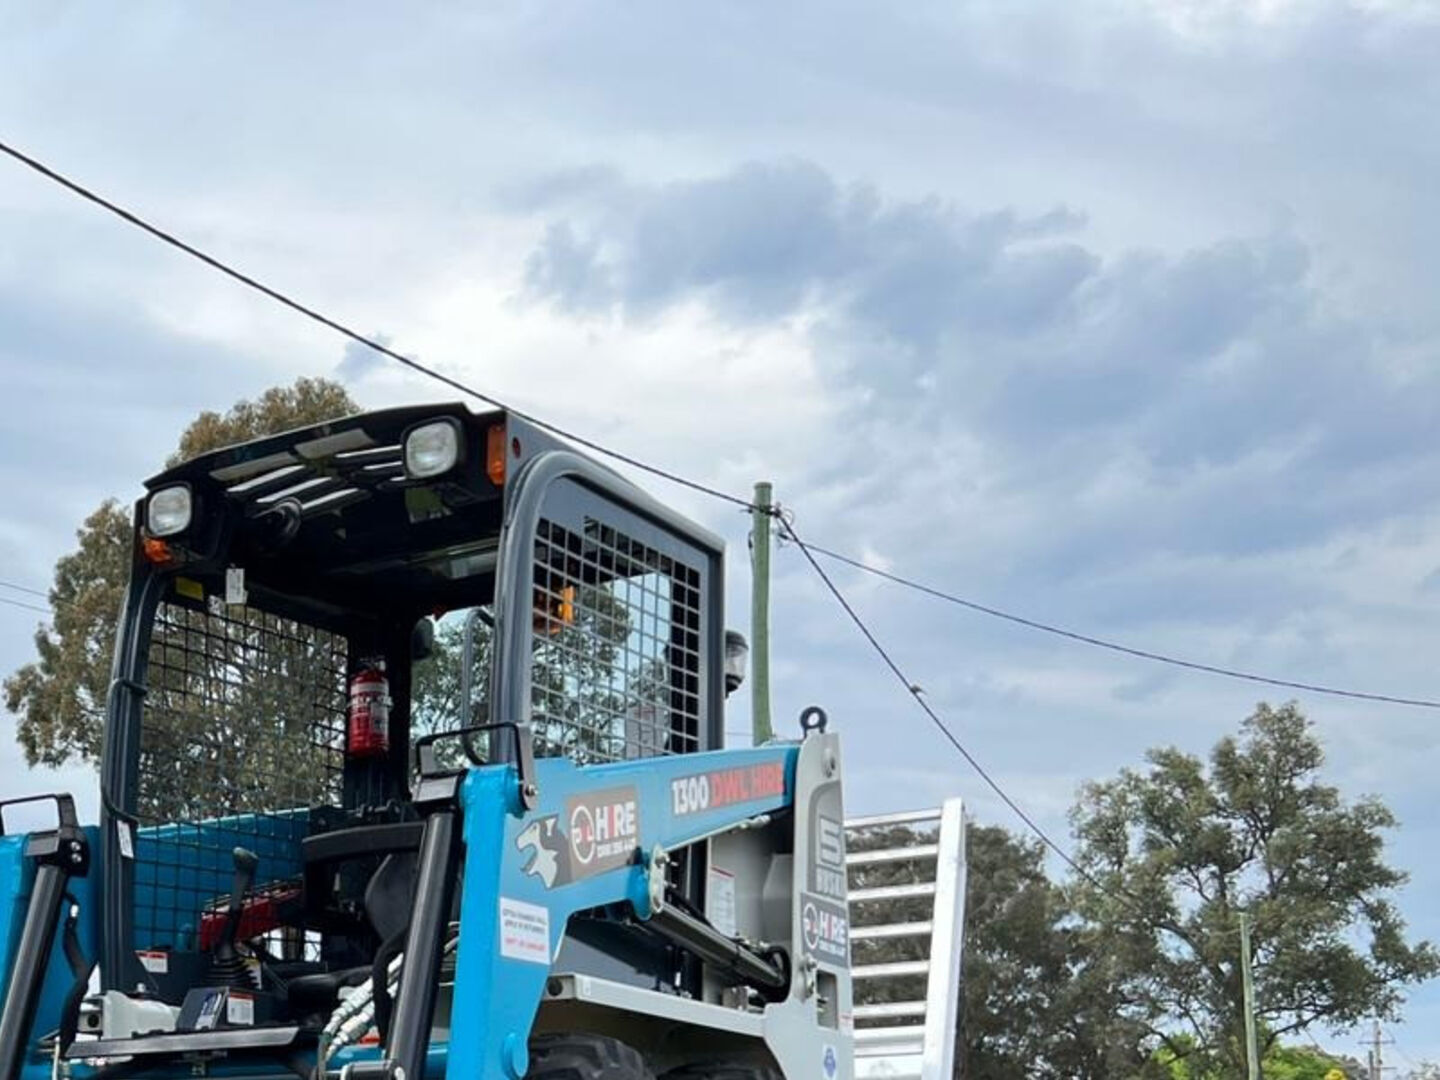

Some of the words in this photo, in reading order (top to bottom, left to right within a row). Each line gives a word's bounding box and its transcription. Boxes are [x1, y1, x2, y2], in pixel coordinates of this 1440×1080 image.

[671, 774, 709, 815] 1300
[710, 770, 750, 807] DWL
[594, 801, 636, 842] HIRE
[819, 909, 847, 946] HIRE
